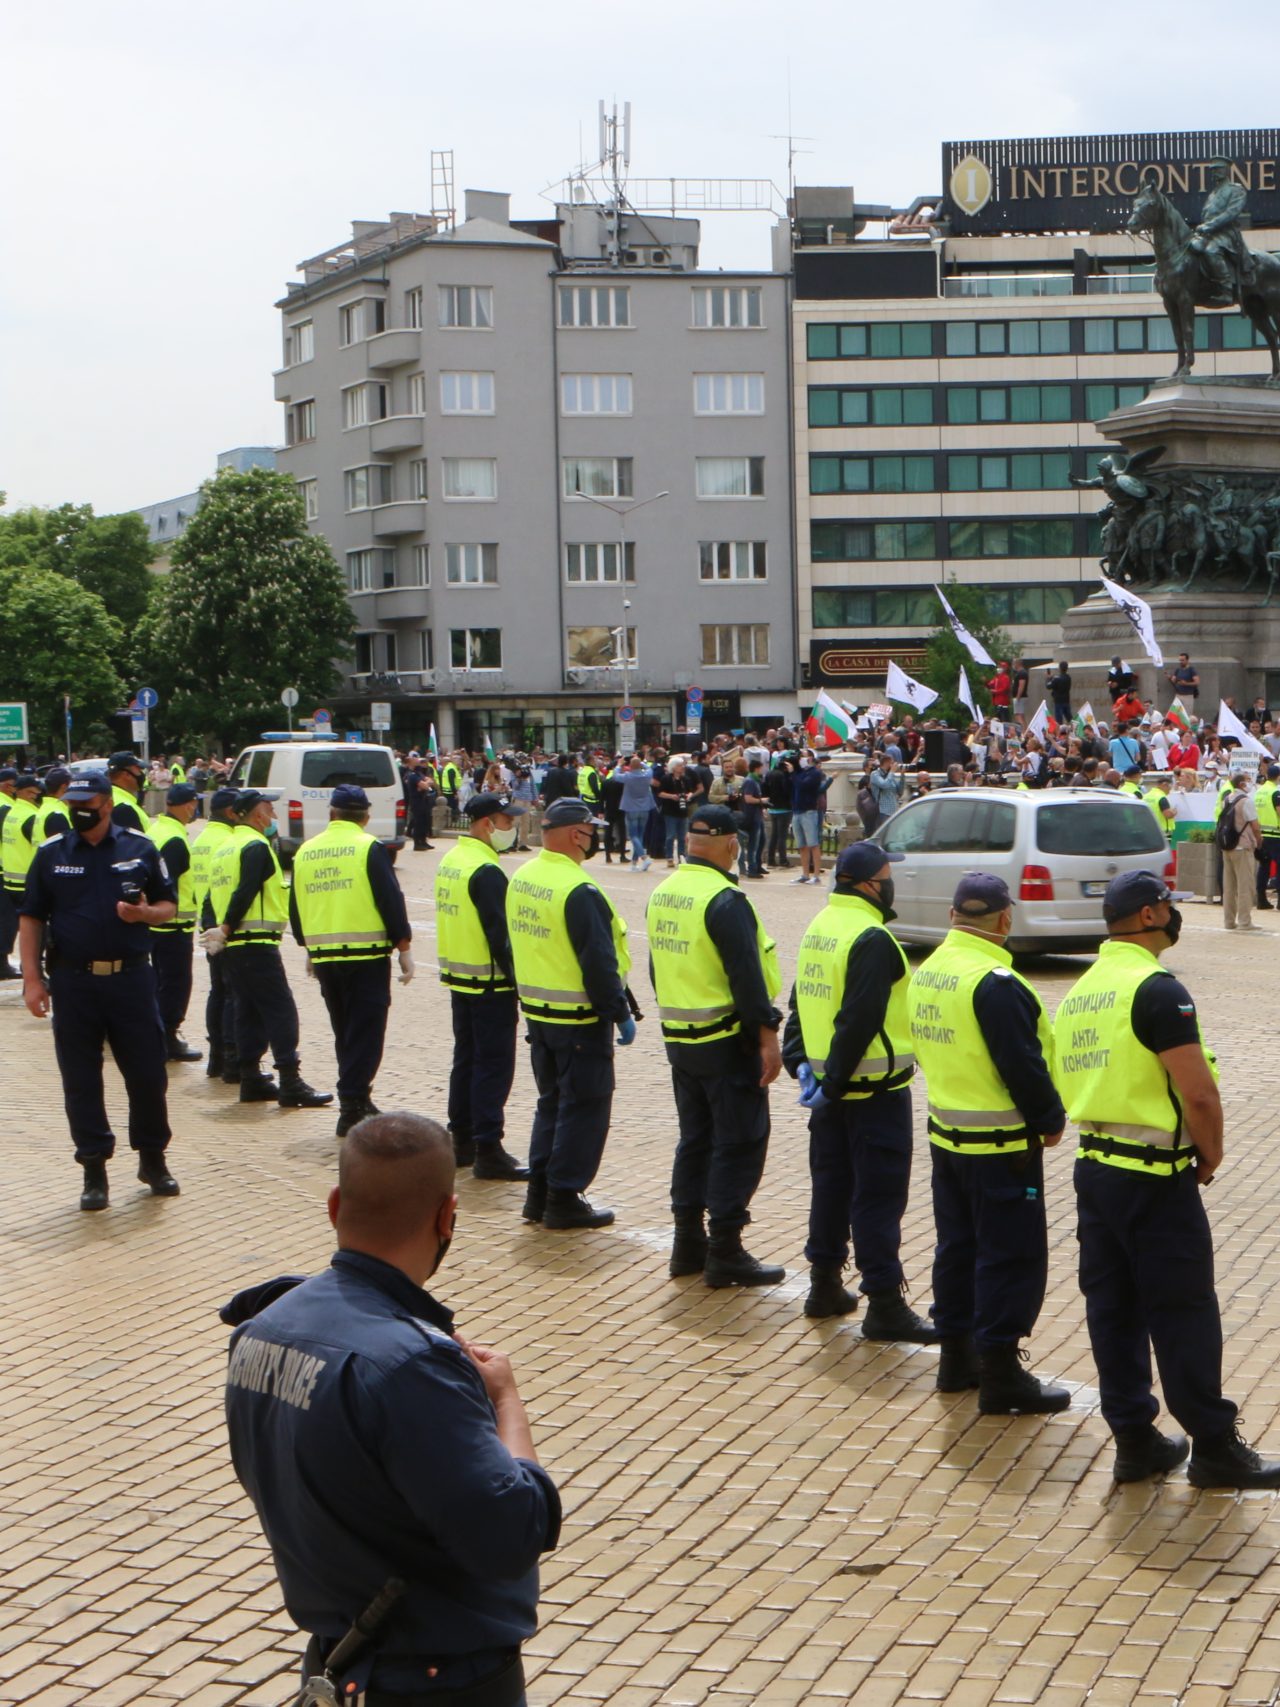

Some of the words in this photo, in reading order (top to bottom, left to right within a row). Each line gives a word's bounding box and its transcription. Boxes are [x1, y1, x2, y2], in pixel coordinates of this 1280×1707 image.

[843, 658, 871, 667] CASA
[303, 790, 331, 799] POLI
[302, 846, 355, 862] ПОЛИЦИЯ
[314, 867, 341, 880] АНТИ-
[1062, 991, 1116, 1015] ПОЛИЦИЯ
[1071, 1027, 1099, 1049] АНТИ-
